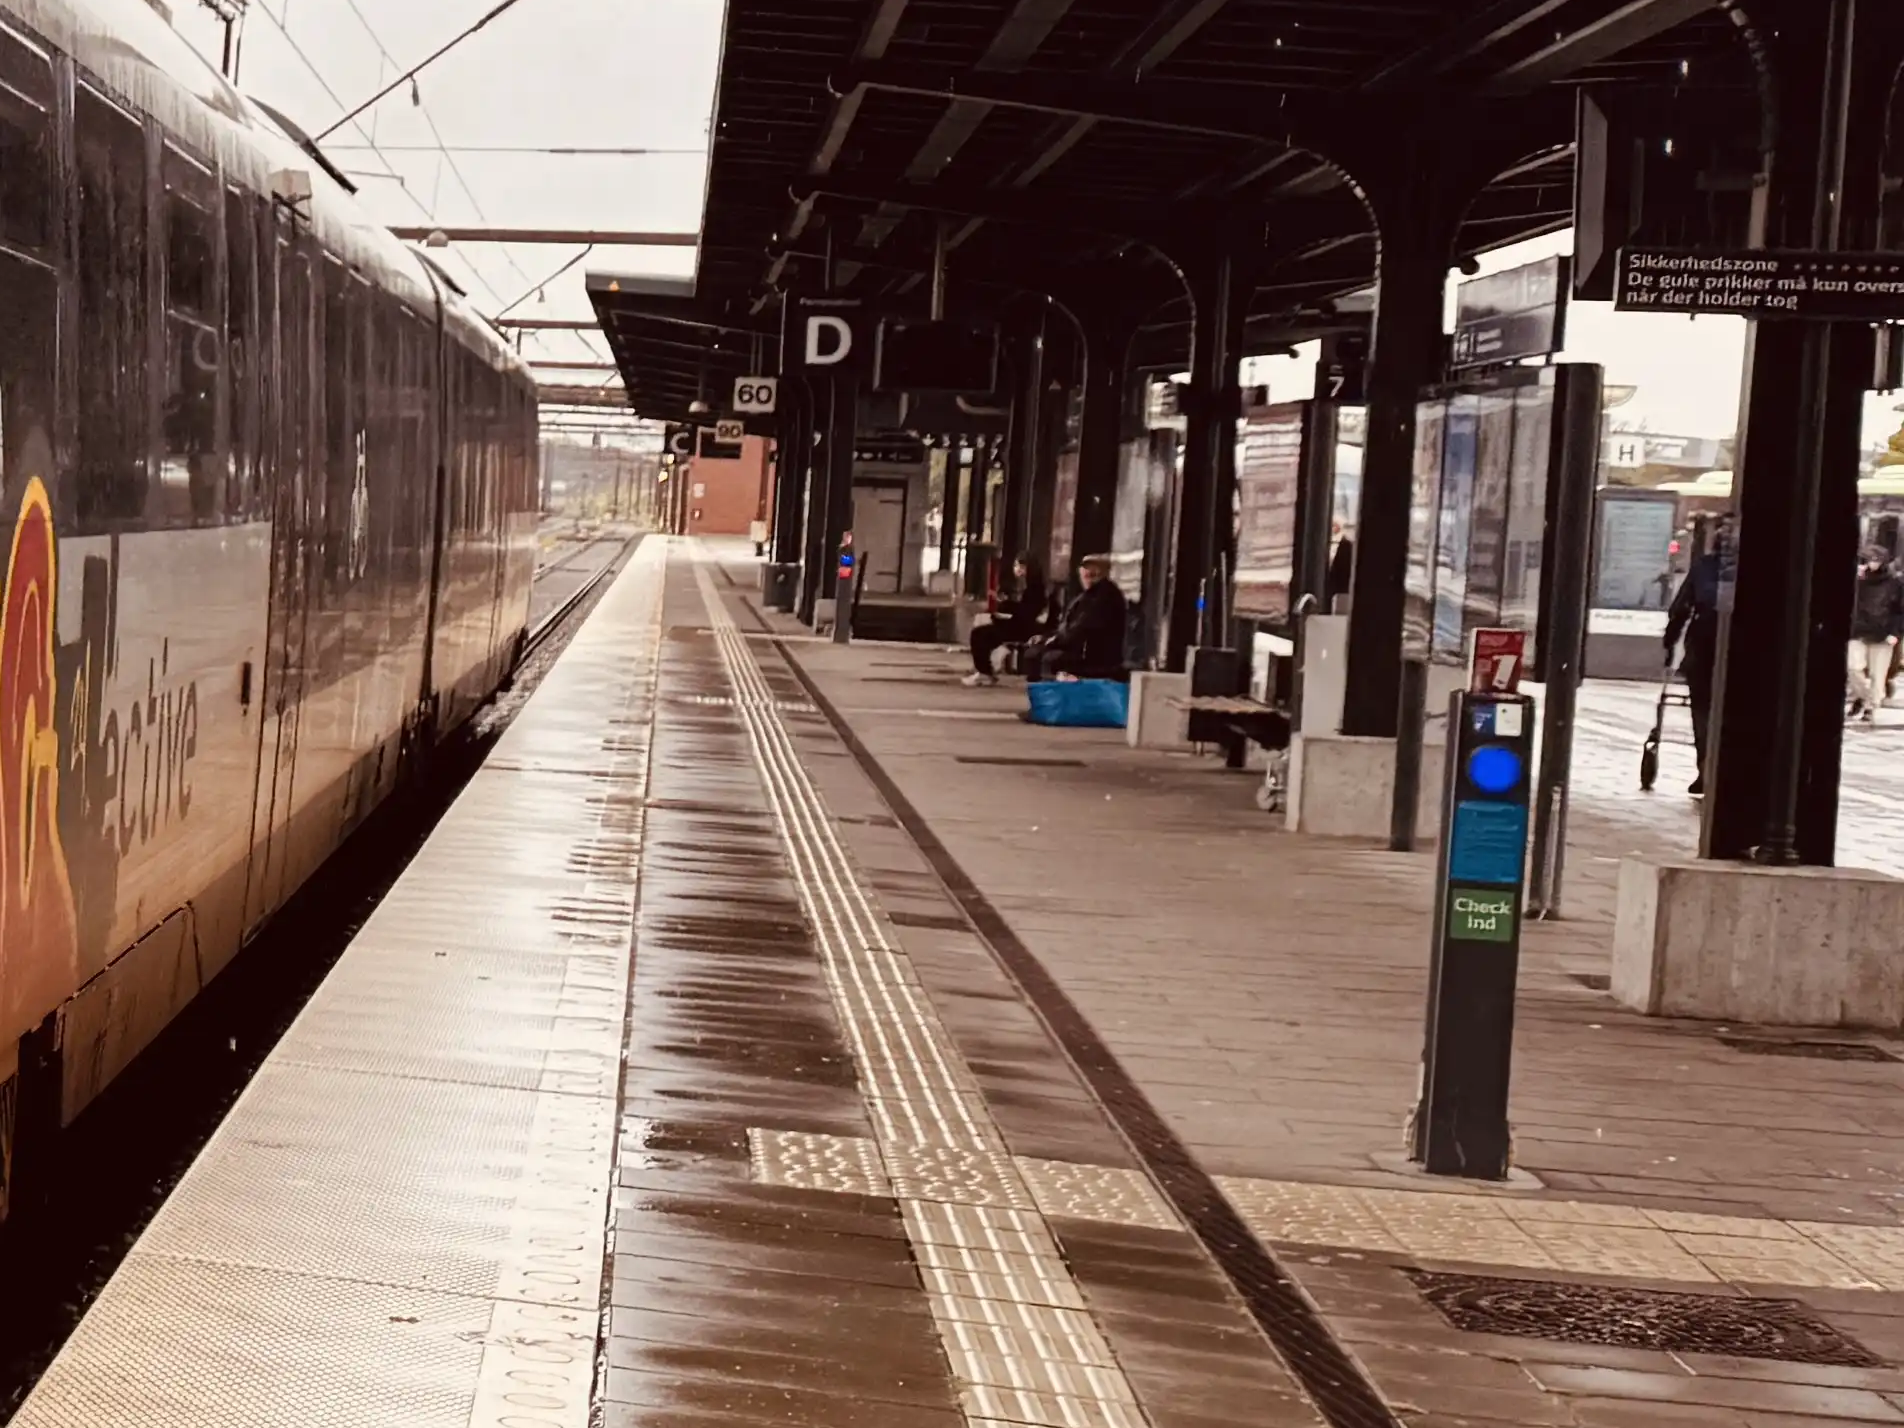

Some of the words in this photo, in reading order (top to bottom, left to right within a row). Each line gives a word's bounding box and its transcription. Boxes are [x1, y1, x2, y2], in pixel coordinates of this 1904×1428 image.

[1629, 253, 1779, 272] Sikkerhedszone
[1627, 272, 1653, 287] De
[1659, 272, 1700, 289] gule
[1705, 274, 1772, 291] prikker
[1777, 275, 1807, 291] må
[1813, 278, 1849, 292] kun
[1626, 289, 1658, 304] når
[1662, 290, 1693, 305] der
[1699, 291, 1761, 307] holder
[804, 315, 853, 365] D
[737, 384, 773, 405] 60
[669, 431, 690, 454] C
[1619, 444, 1635, 461] H
[1454, 897, 1512, 917] Check
